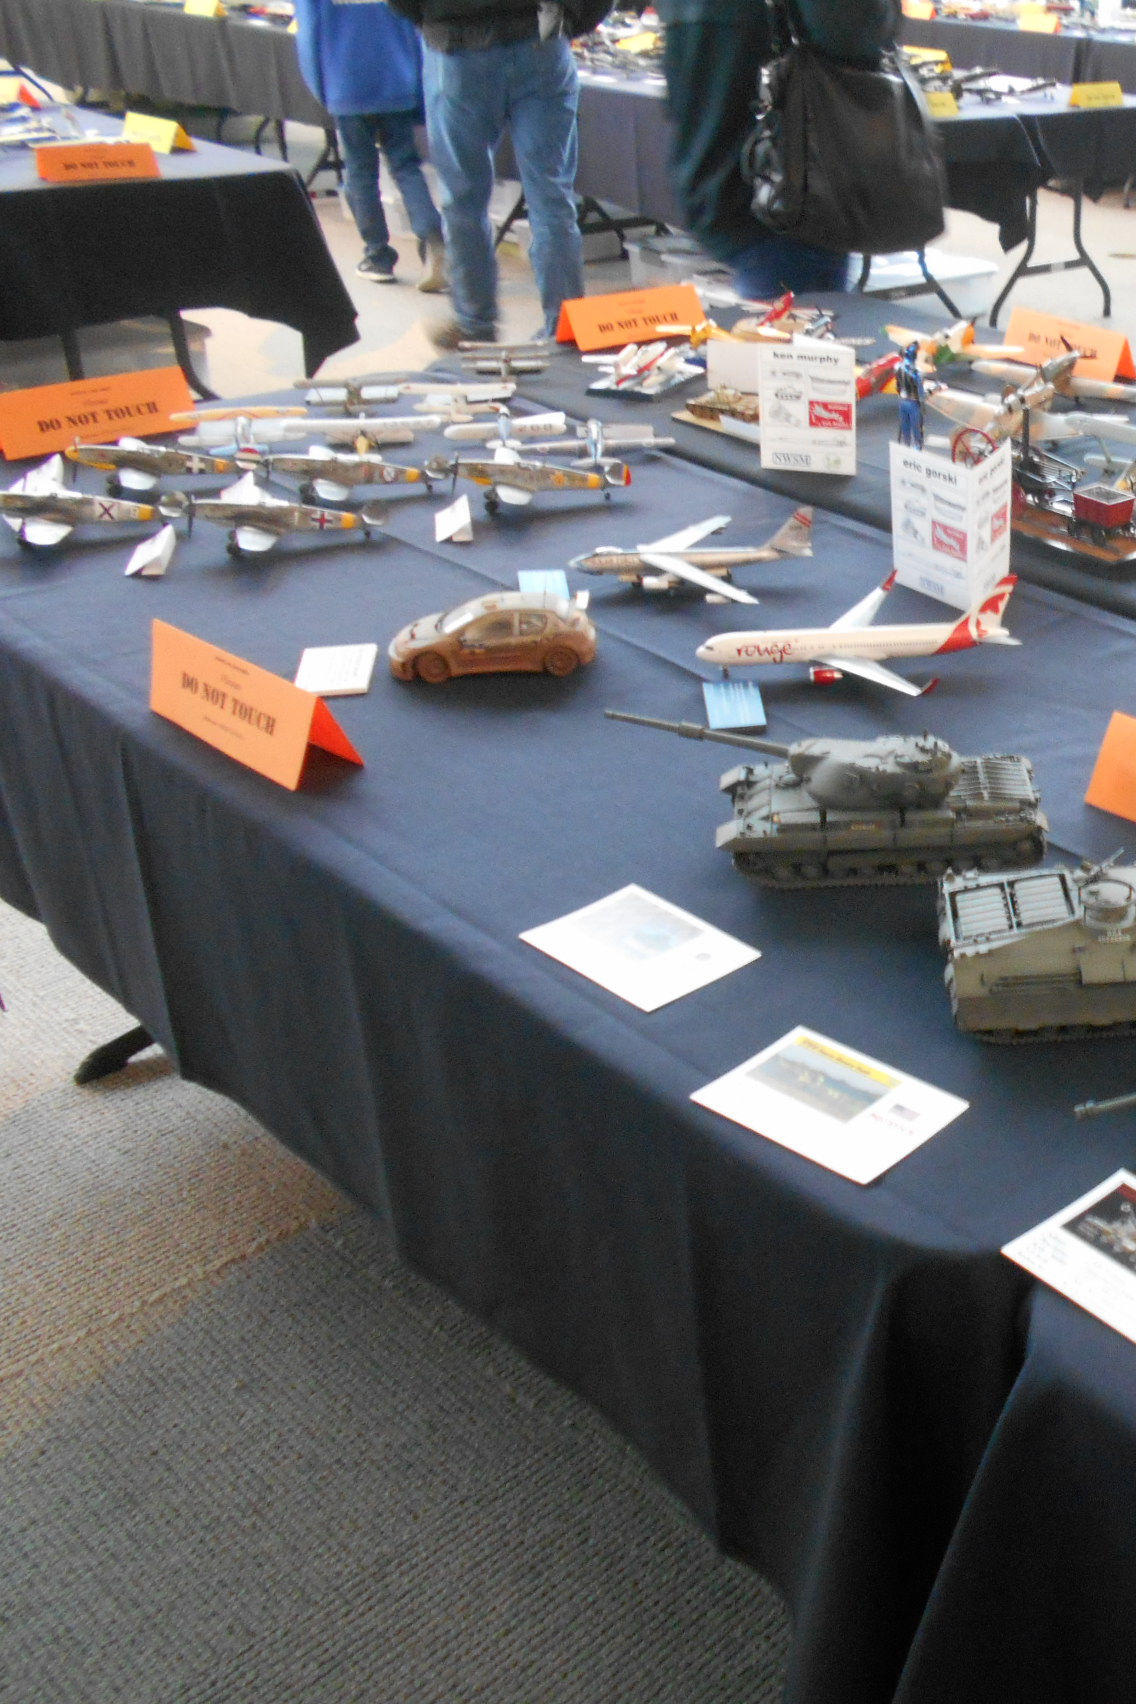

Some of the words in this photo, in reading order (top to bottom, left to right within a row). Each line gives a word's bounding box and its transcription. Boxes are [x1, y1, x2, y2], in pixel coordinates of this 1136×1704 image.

[598, 322, 614, 333] DO
[616, 319, 639, 330] NOT
[642, 312, 679, 326] TOUCH
[773, 351, 793, 360] ken
[797, 354, 840, 365] murphy
[37, 418, 62, 434] DO
[65, 411, 99, 429] NOT
[104, 401, 159, 423] TOUCH
[903, 458, 922, 473] eric
[925, 467, 958, 487] gorski
[736, 642, 792, 664] rouge
[181, 671, 199, 695] DO
[202, 681, 228, 710] NOT
[231, 696, 277, 737] TOUCH
